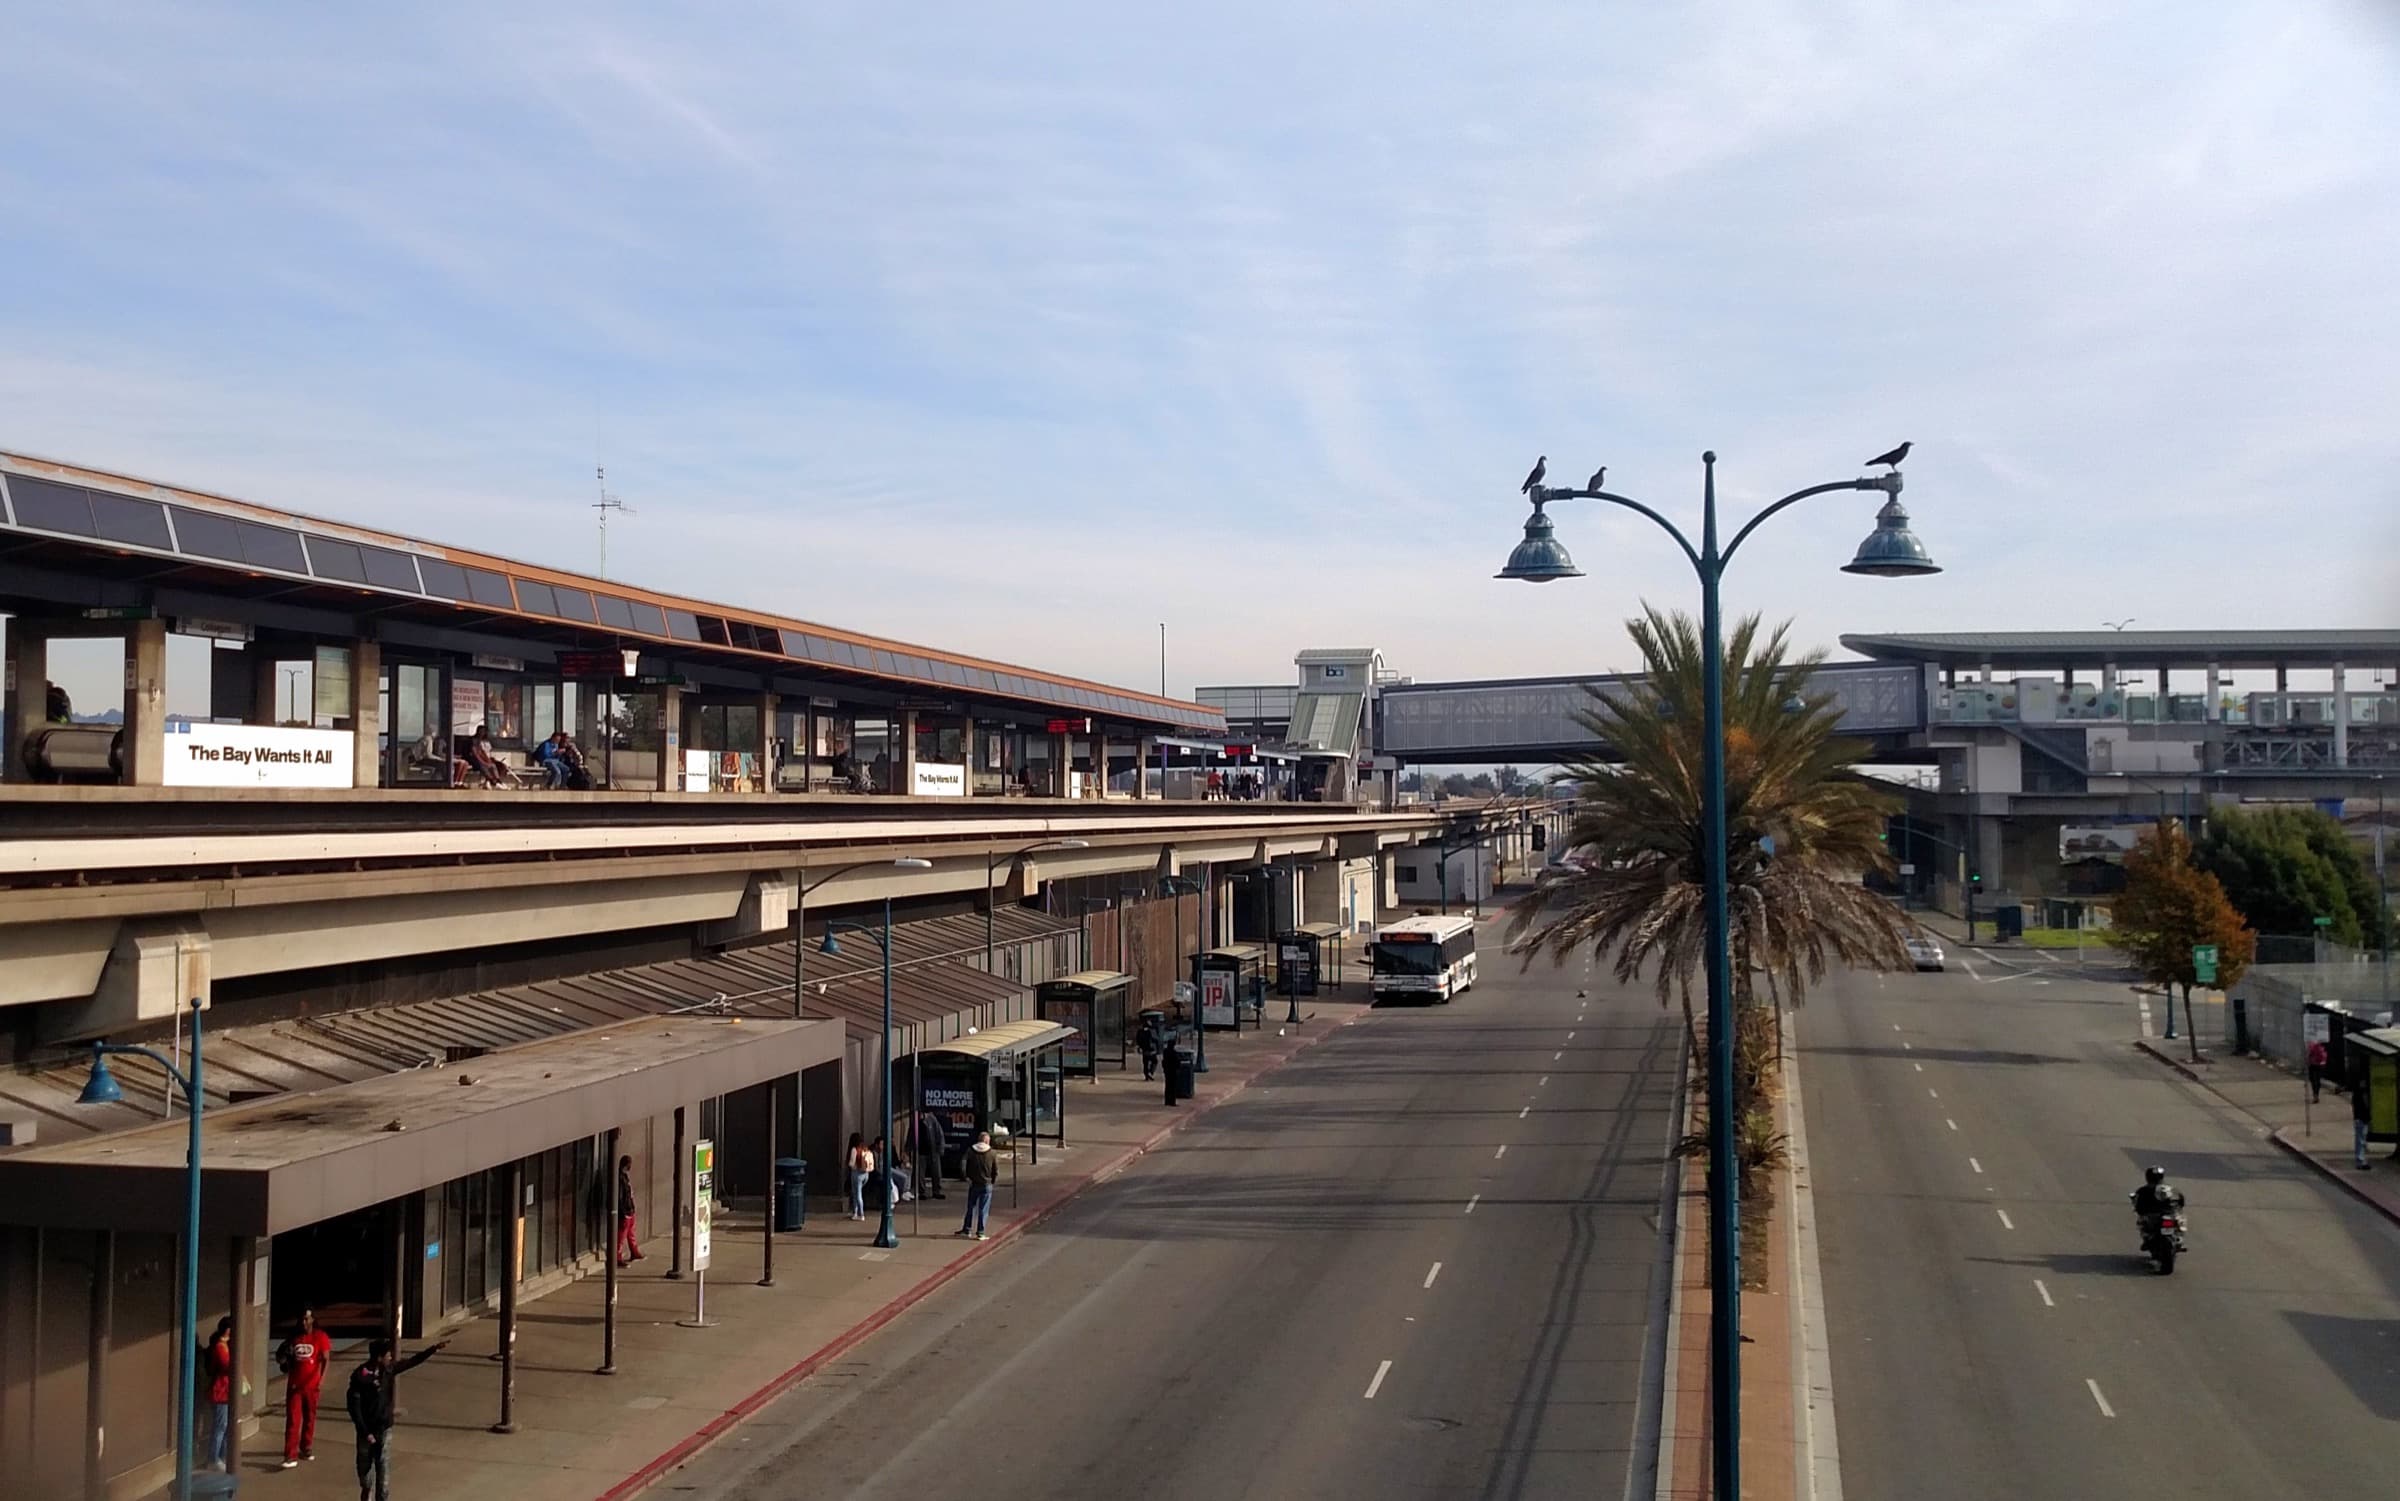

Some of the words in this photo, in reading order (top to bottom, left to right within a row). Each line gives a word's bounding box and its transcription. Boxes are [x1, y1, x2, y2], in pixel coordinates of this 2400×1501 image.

[189, 745, 220, 761] The
[223, 746, 252, 765] Bay
[255, 747, 301, 764] Wants
[303, 749, 312, 763] It
[315, 750, 333, 764] All
[919, 774, 927, 783] The
[928, 774, 936, 784] Bay
[936, 775, 949, 783] Wants
[925, 1089, 941, 1098] NO
[943, 1090, 974, 1100] MORE
[925, 1098, 948, 1107] DATA
[949, 1099, 974, 1108] CAPS
